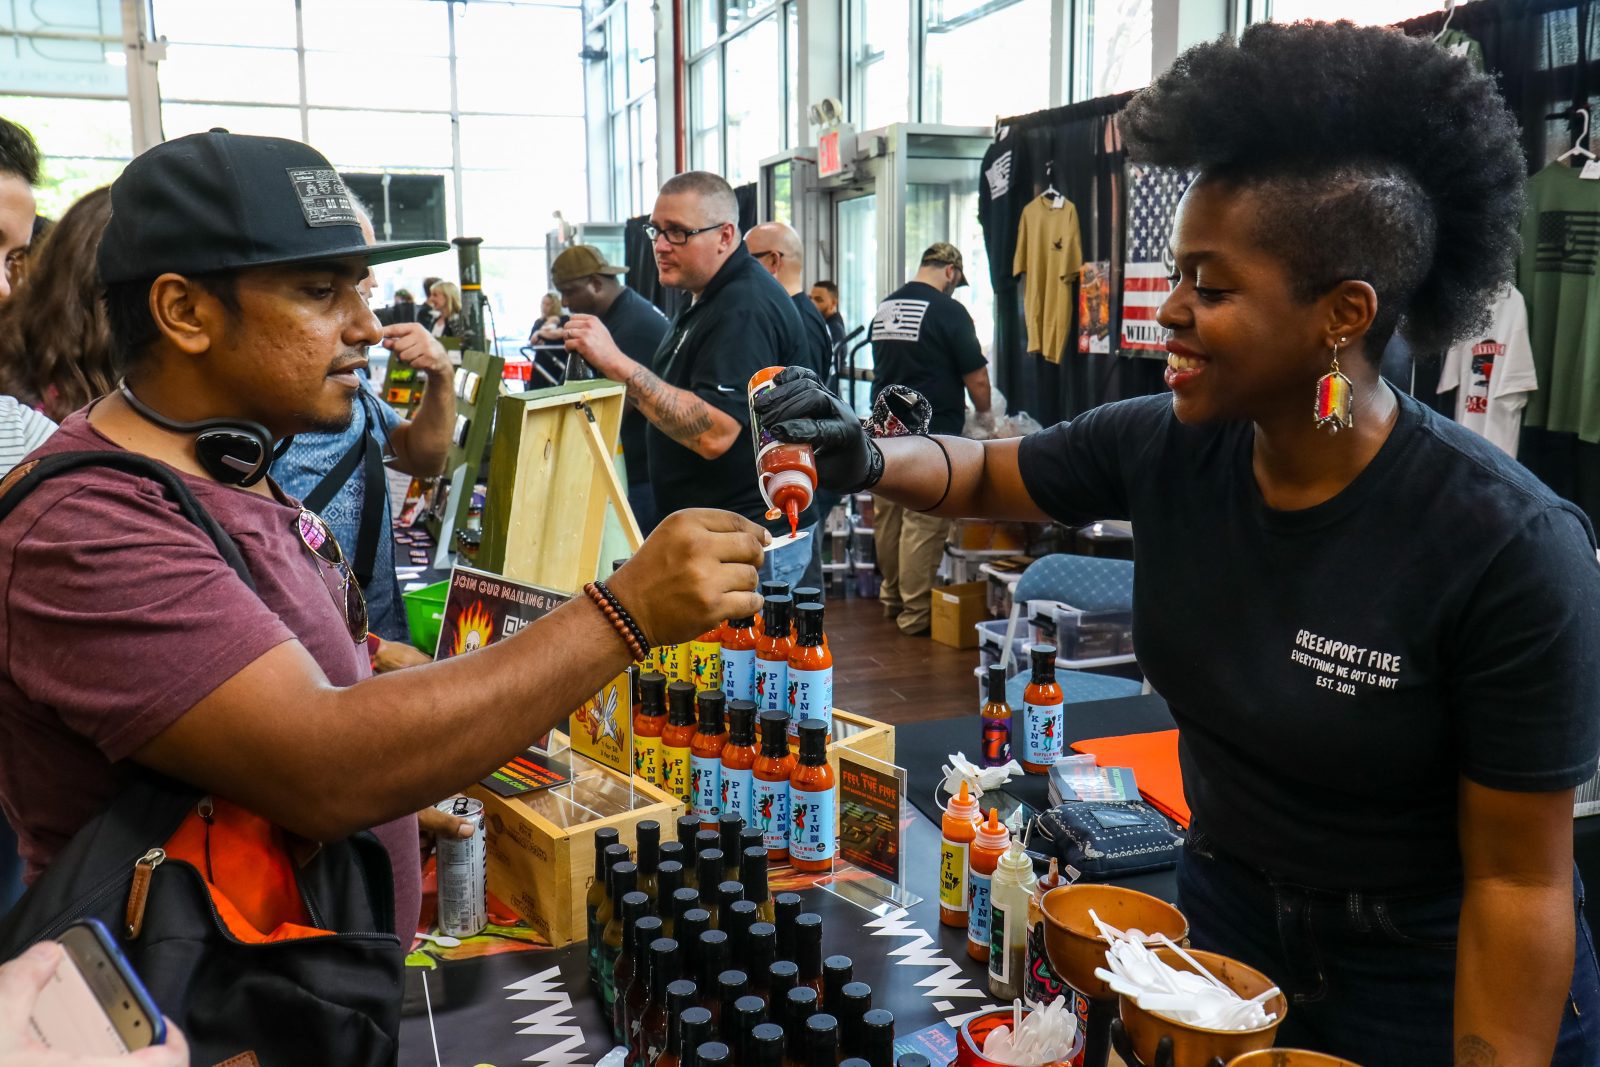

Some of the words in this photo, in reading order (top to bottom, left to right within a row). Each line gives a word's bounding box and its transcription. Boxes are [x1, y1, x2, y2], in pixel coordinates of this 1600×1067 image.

[1126, 325, 1159, 342] WILLY
[453, 574, 478, 591] JOIN
[478, 580, 500, 597] OUR
[500, 586, 545, 609] MAILING
[545, 597, 567, 611] LIS
[1290, 649, 1335, 674] EVERYTHING
[1336, 664, 1350, 678] WE
[1350, 669, 1367, 682] GOT
[1367, 673, 1377, 685] IS
[1378, 675, 1399, 690] HOT
[1295, 629, 1368, 665] GREENPORT
[1367, 650, 1401, 673] FIRE
[1316, 675, 1334, 690] EST.
[1335, 681, 1356, 696] 2012
